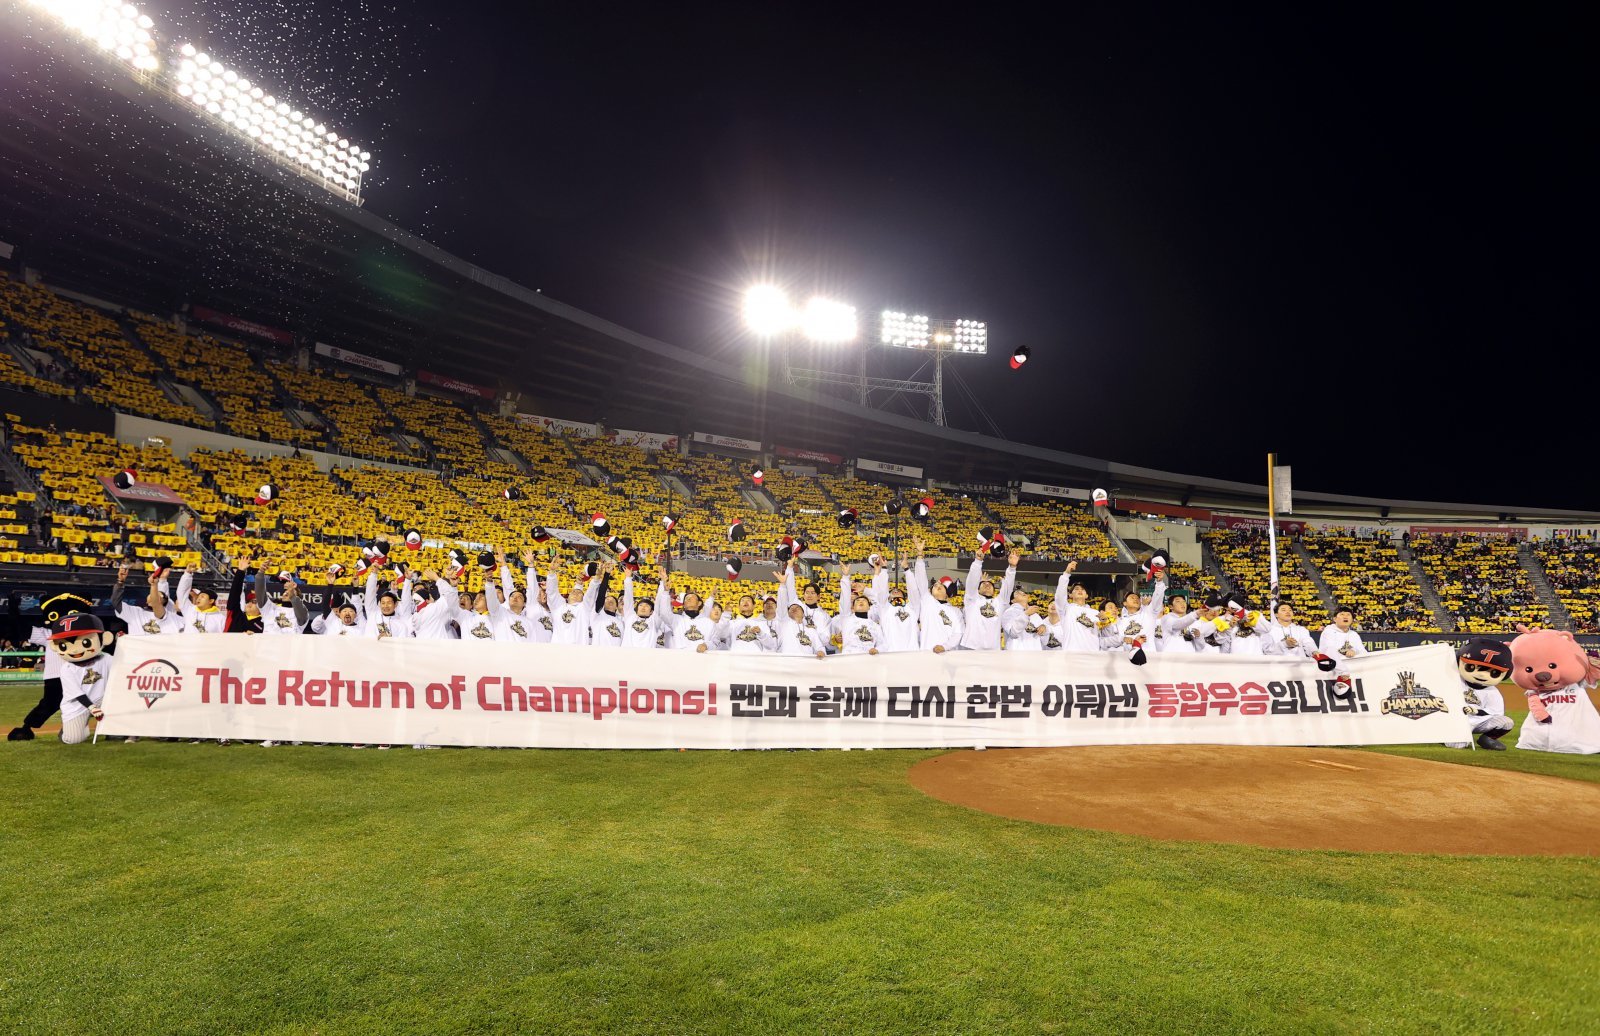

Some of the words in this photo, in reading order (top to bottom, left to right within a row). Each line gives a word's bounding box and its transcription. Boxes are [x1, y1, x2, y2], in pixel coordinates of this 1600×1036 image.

[344, 356, 385, 371] CHAMPIONS
[59, 615, 79, 632] T
[1480, 648, 1501, 664] T
[150, 666, 162, 674] LG
[126, 675, 183, 692] TWINS
[196, 668, 266, 704] The
[278, 670, 414, 709] Return
[426, 676, 465, 709] of
[478, 677, 716, 720] Champions!
[730, 684, 800, 717] 팬과
[810, 686, 877, 718] 함께
[888, 686, 955, 718] 다시
[967, 685, 1031, 718] 한번
[1042, 683, 1139, 718] 이뤄낸
[1147, 680, 1368, 717] 통합우승입니다!
[1540, 695, 1576, 707] TWINS
[1381, 697, 1449, 714] CHAMPIONS
